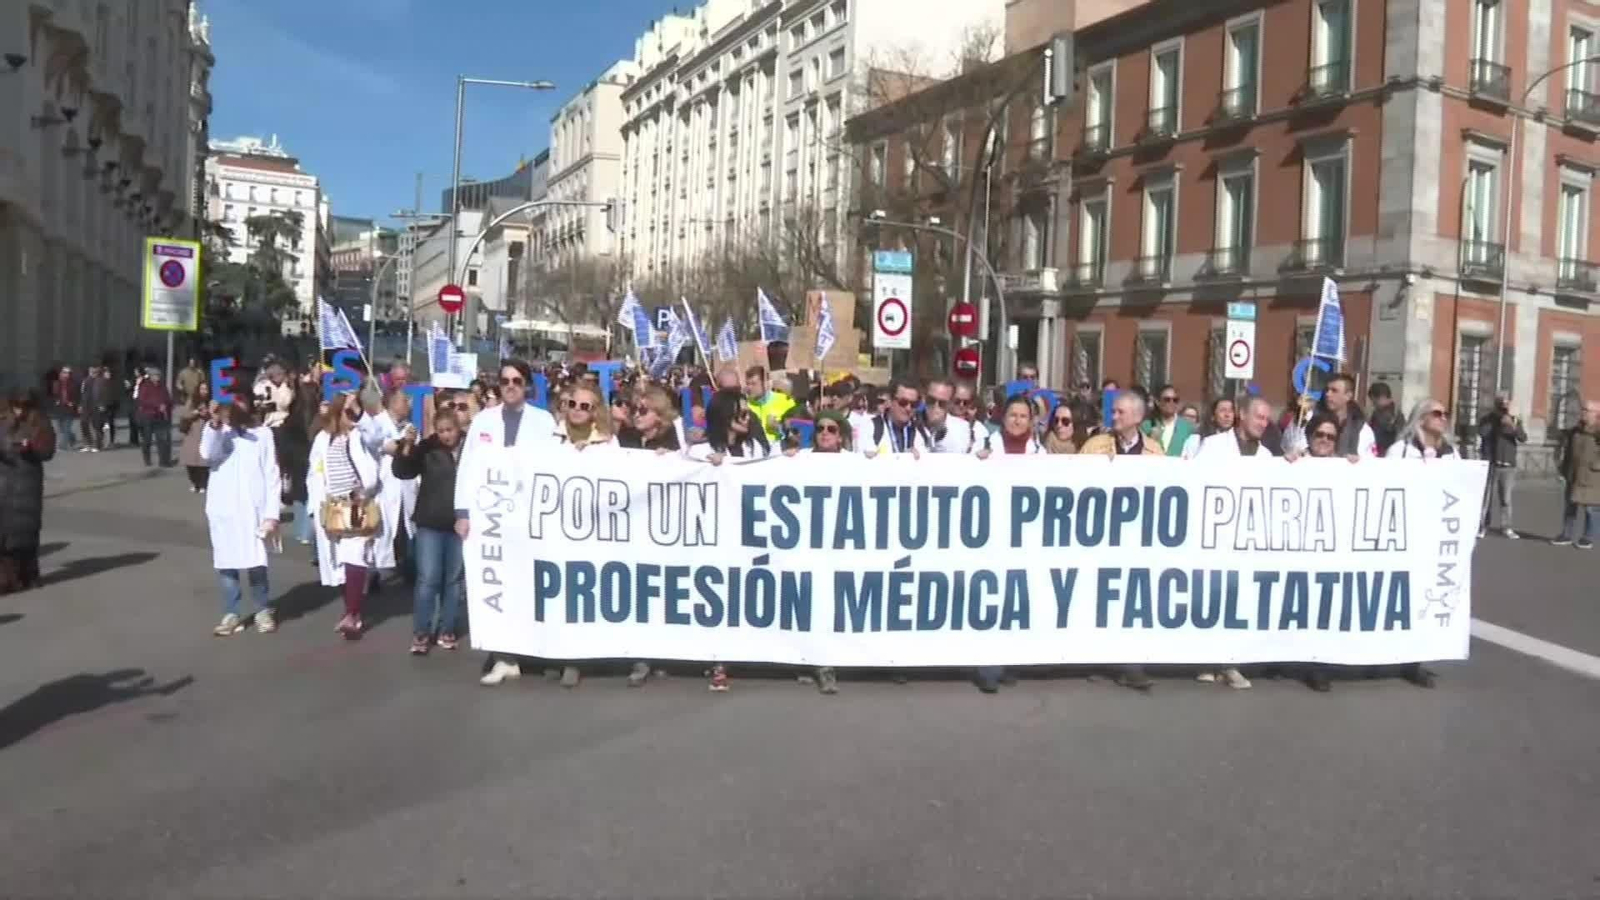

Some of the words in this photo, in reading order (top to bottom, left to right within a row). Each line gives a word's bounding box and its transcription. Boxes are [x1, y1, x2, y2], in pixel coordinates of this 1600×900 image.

[210, 356, 240, 405] E
[322, 349, 362, 402] S
[587, 361, 623, 406] T
[402, 384, 435, 435] T
[529, 473, 630, 542] POR
[647, 482, 719, 547] UN
[741, 484, 990, 550] ESTATUTO
[1010, 486, 1189, 548] PROPIO
[1201, 486, 1337, 552] PARA
[1351, 488, 1408, 553] LA
[534, 553, 812, 632] PROFESIÓN
[832, 555, 1030, 633] MÉDICA
[1050, 567, 1079, 630] Y
[1095, 567, 1411, 632] FACULTATIVA
